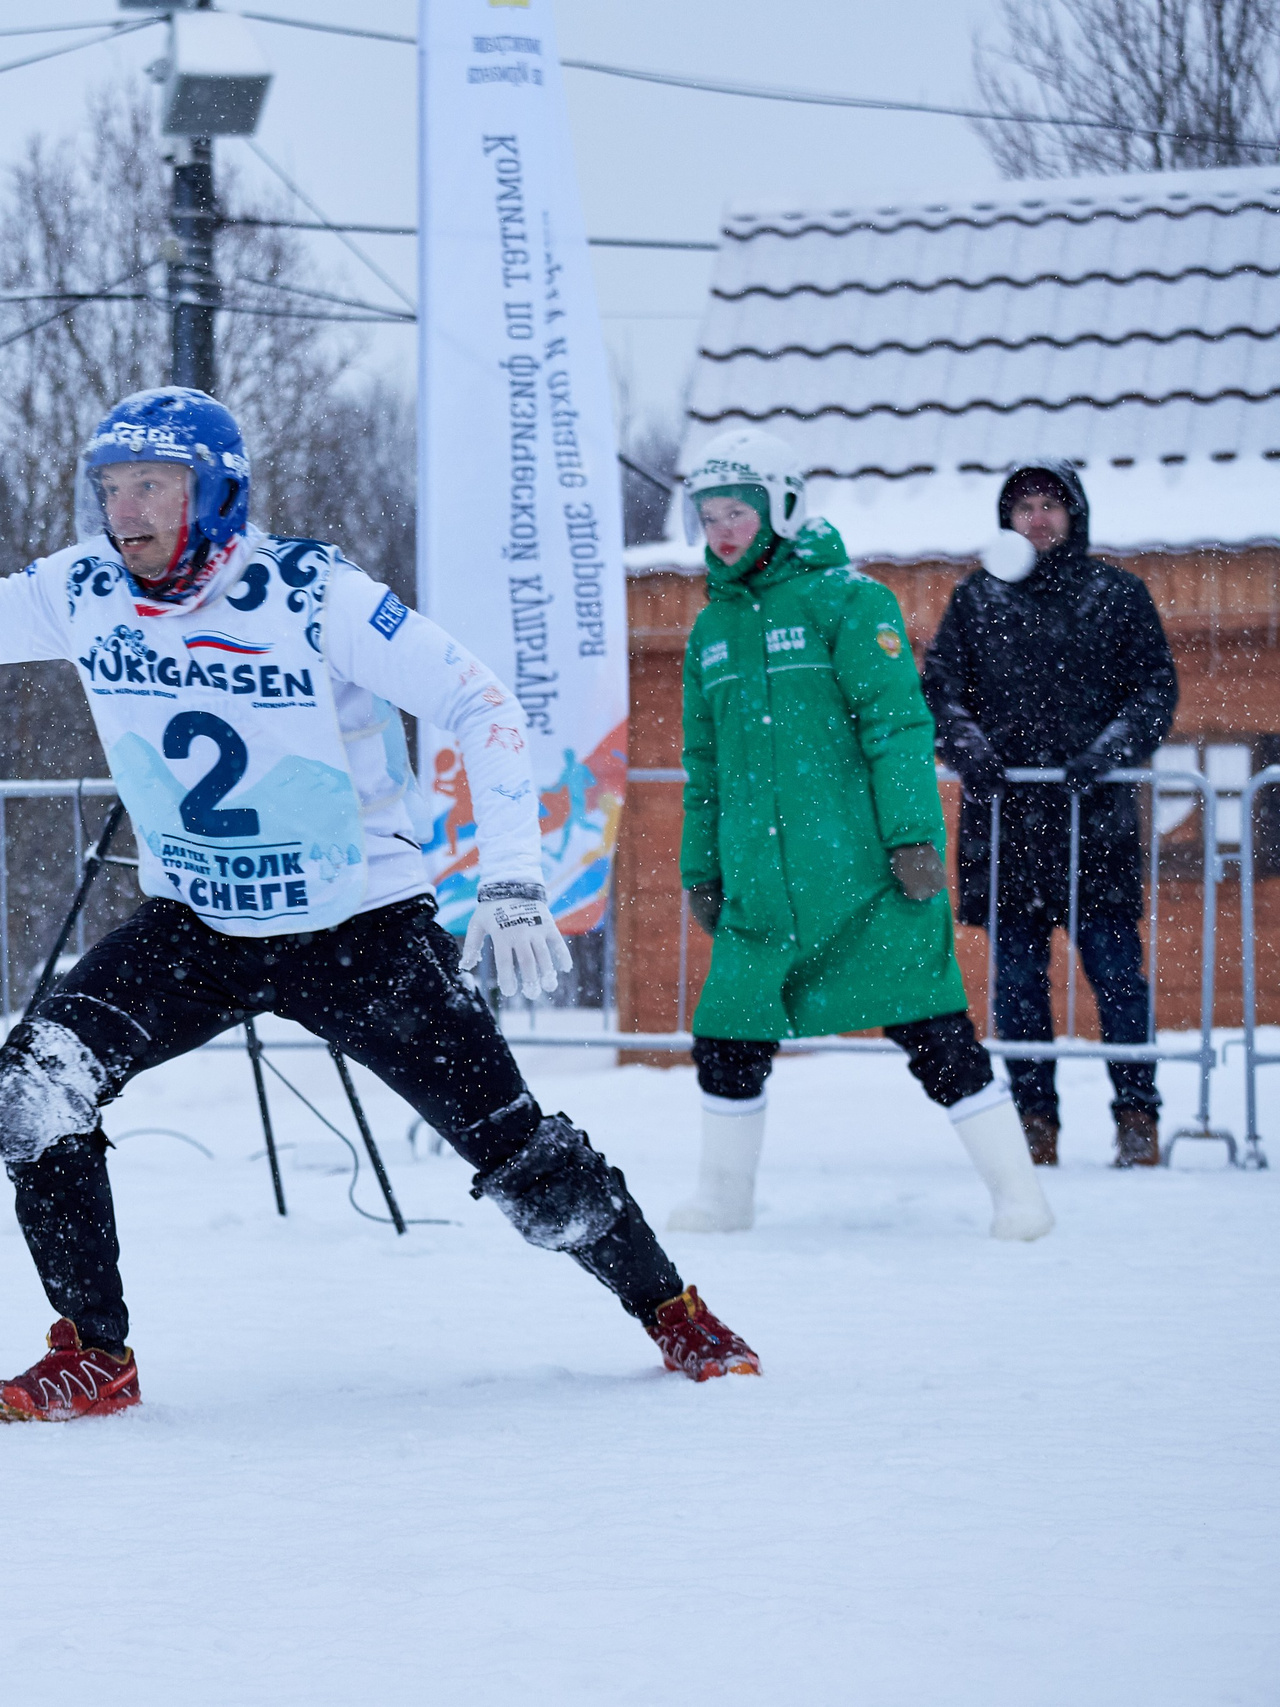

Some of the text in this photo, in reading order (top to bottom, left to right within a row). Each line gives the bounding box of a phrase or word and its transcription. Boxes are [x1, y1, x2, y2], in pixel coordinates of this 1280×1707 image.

[163, 711, 260, 837] 2
[214, 852, 305, 879] ТОЛК
[189, 877, 308, 911] СНЕГЕ
